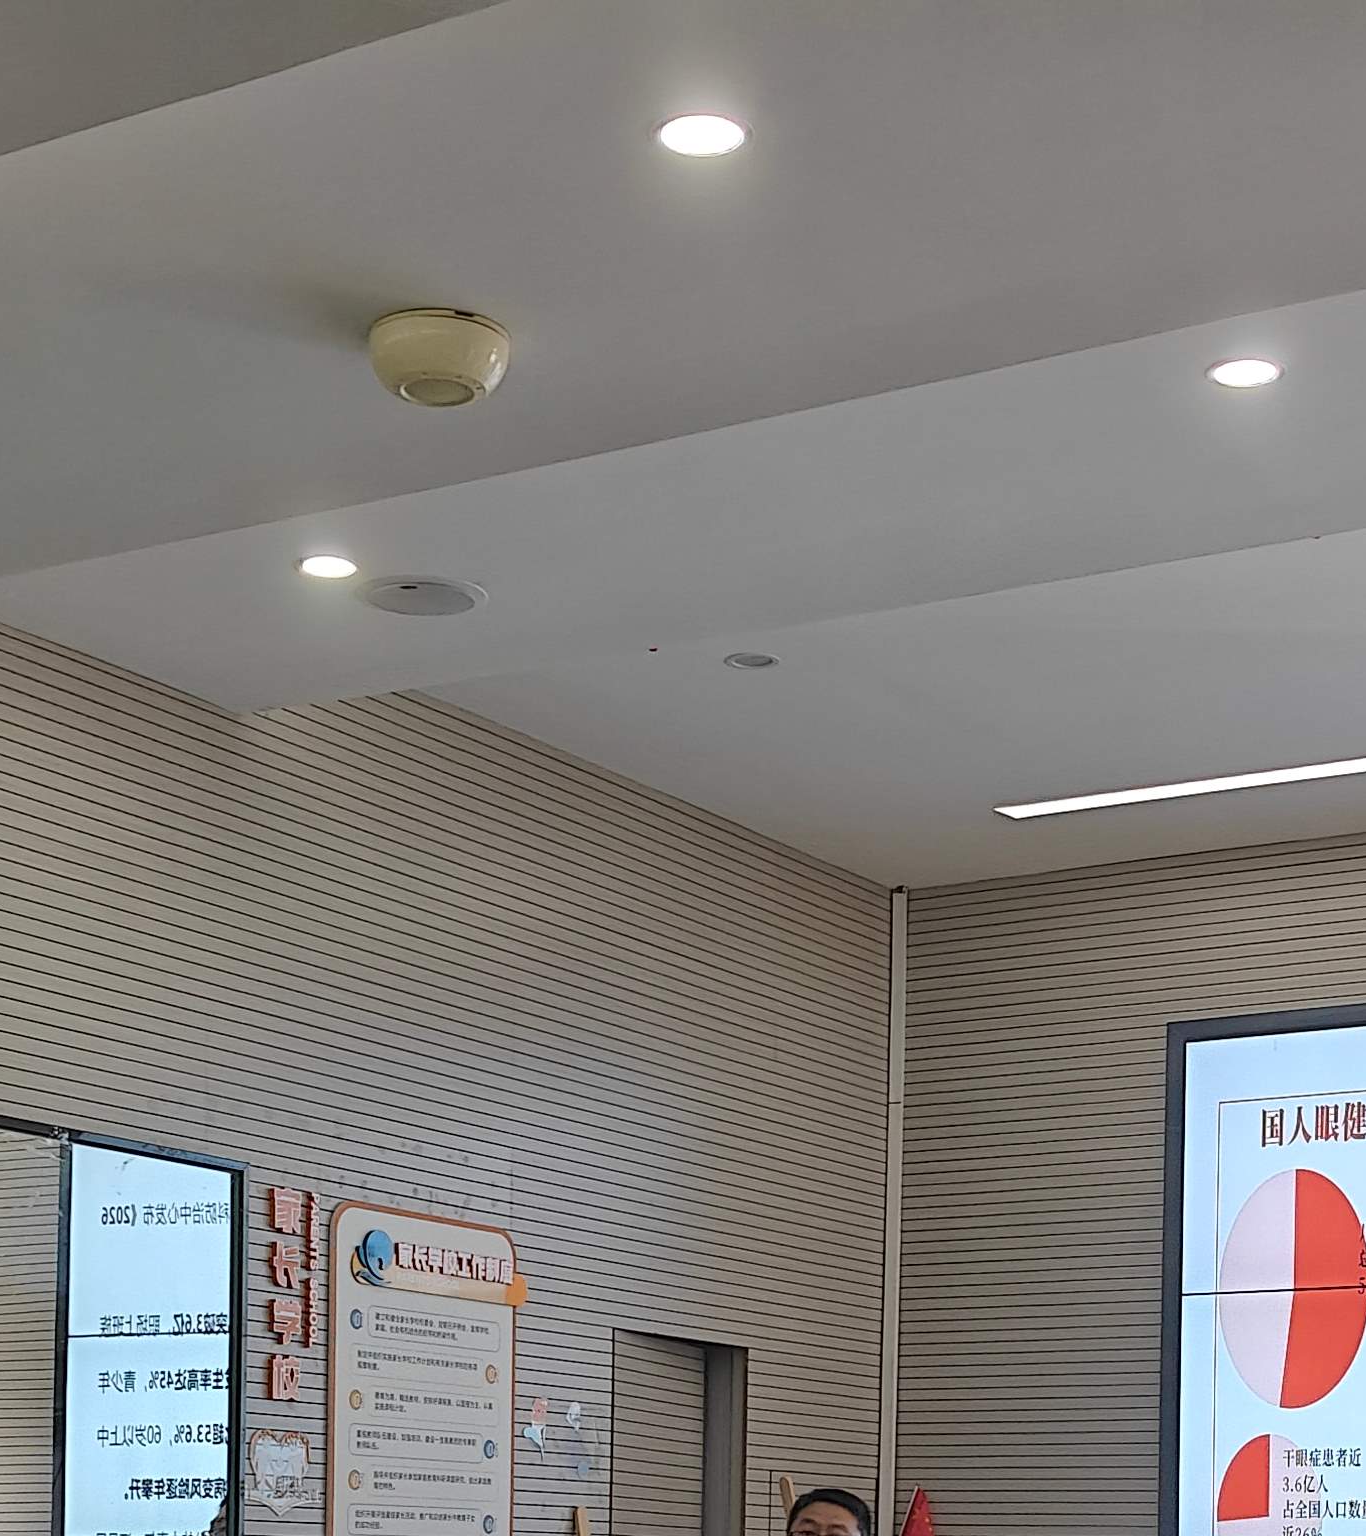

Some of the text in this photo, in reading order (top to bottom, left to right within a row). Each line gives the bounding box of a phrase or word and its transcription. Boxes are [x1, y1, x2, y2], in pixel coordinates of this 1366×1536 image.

[270, 1187, 302, 1402] 家长学校
[307, 1277, 320, 1348] SCHOOL
[1282, 1447, 1362, 1468] 干眼症患者近
[1282, 1475, 1330, 1494] 3.6亿人
